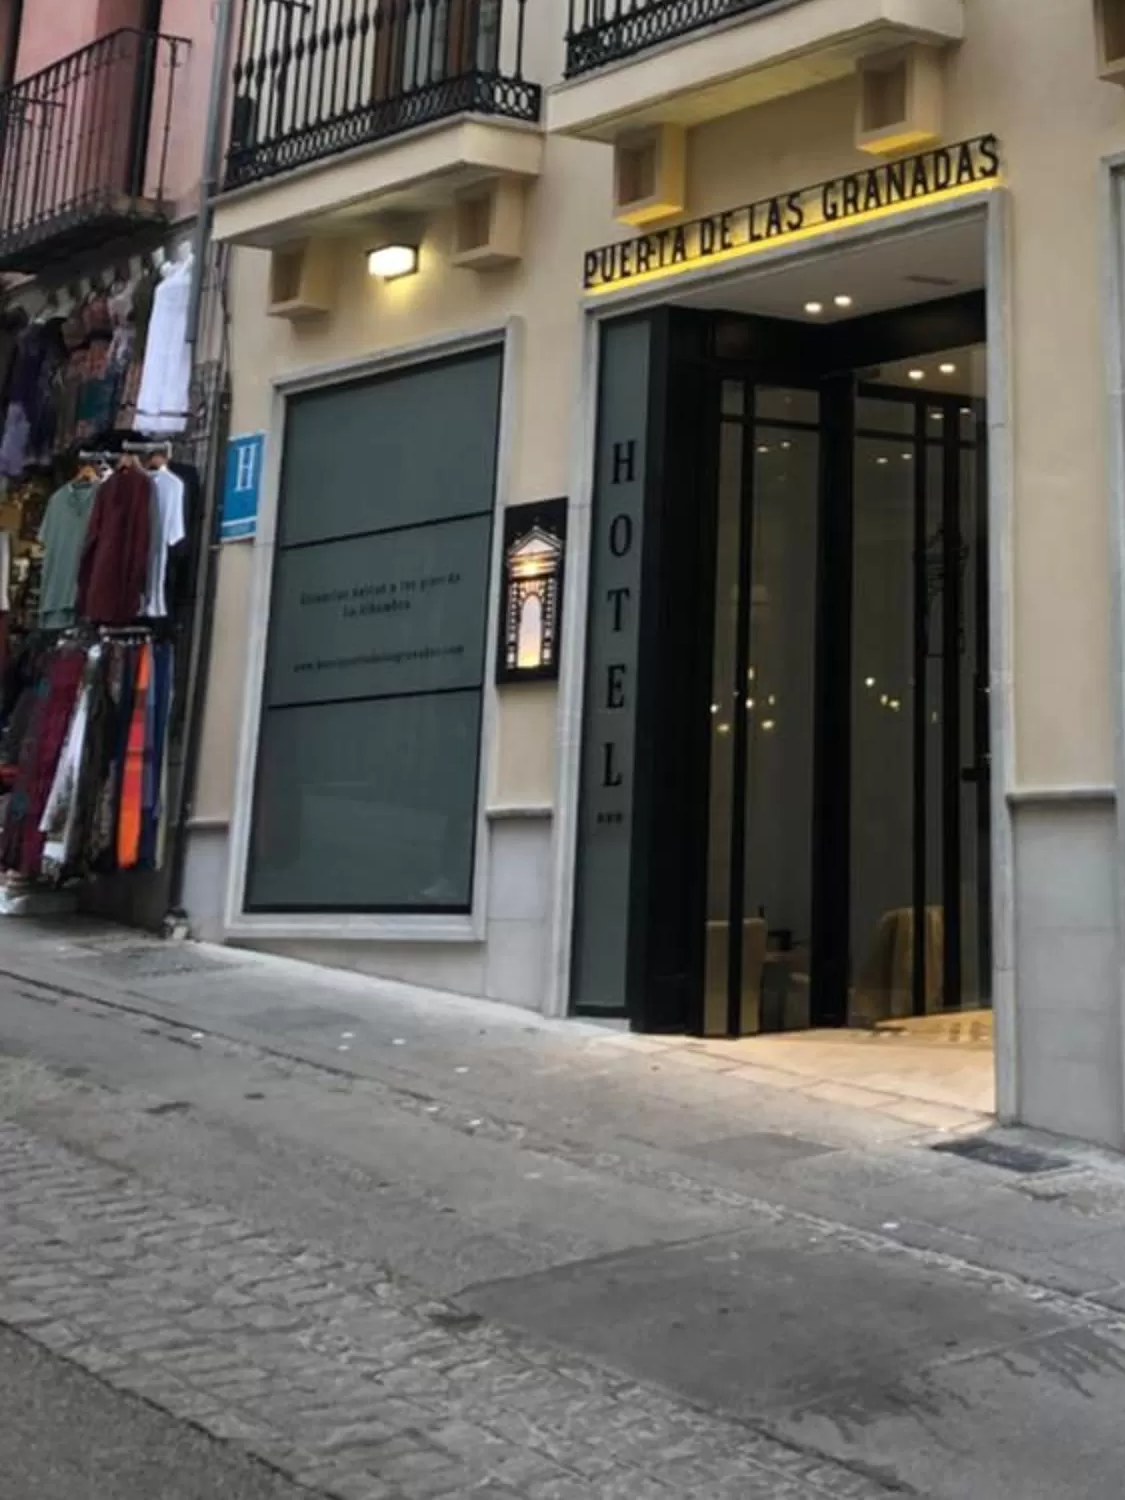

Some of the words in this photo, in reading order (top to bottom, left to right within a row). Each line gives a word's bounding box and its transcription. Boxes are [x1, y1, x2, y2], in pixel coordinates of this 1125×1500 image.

[583, 226, 688, 290] PUERTA
[700, 211, 734, 256] DE
[748, 191, 804, 241] LAS
[822, 134, 1000, 222] GRANADAS
[235, 443, 259, 493] H
[601, 439, 638, 789] HOTEL
